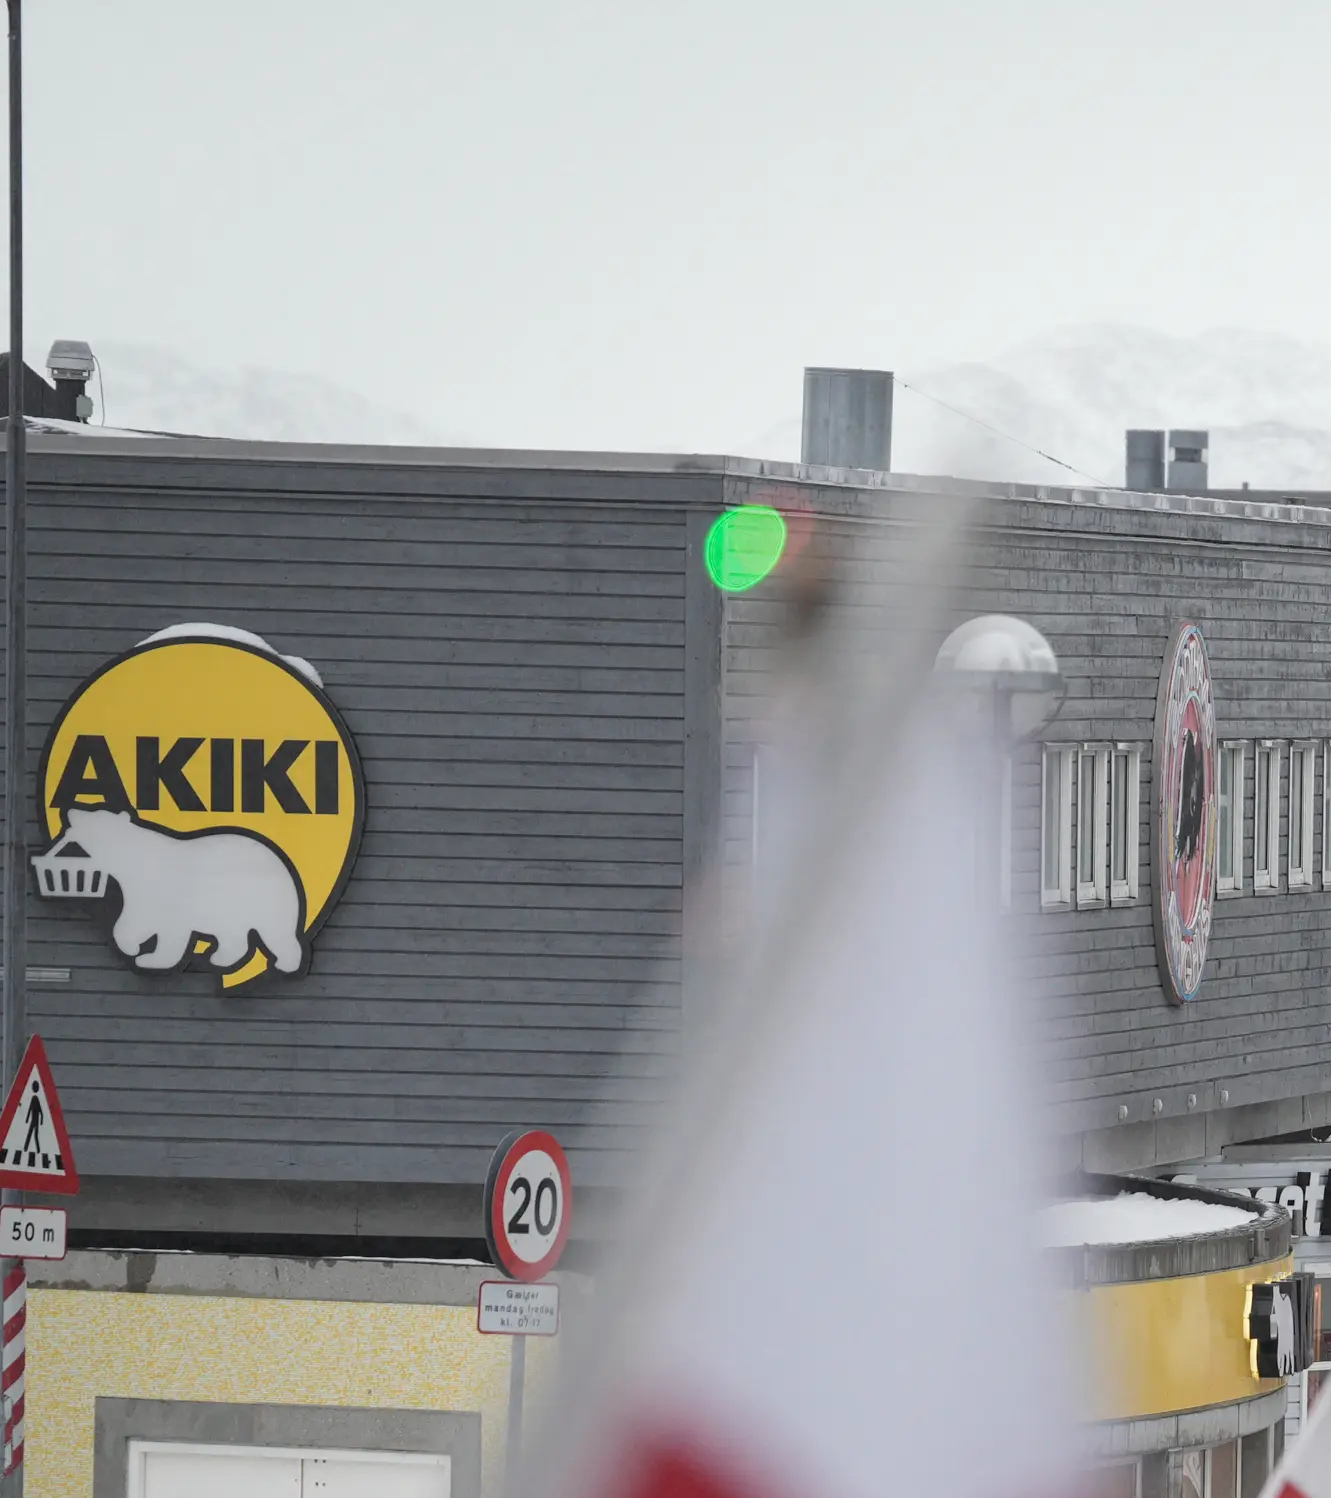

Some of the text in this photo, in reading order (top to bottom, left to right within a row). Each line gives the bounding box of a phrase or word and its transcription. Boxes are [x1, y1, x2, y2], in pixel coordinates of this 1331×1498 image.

[50, 734, 339, 815] AKIKI
[507, 1176, 558, 1237] 20
[12, 1221, 55, 1243] 50 m
[485, 1304, 524, 1315] mandag
